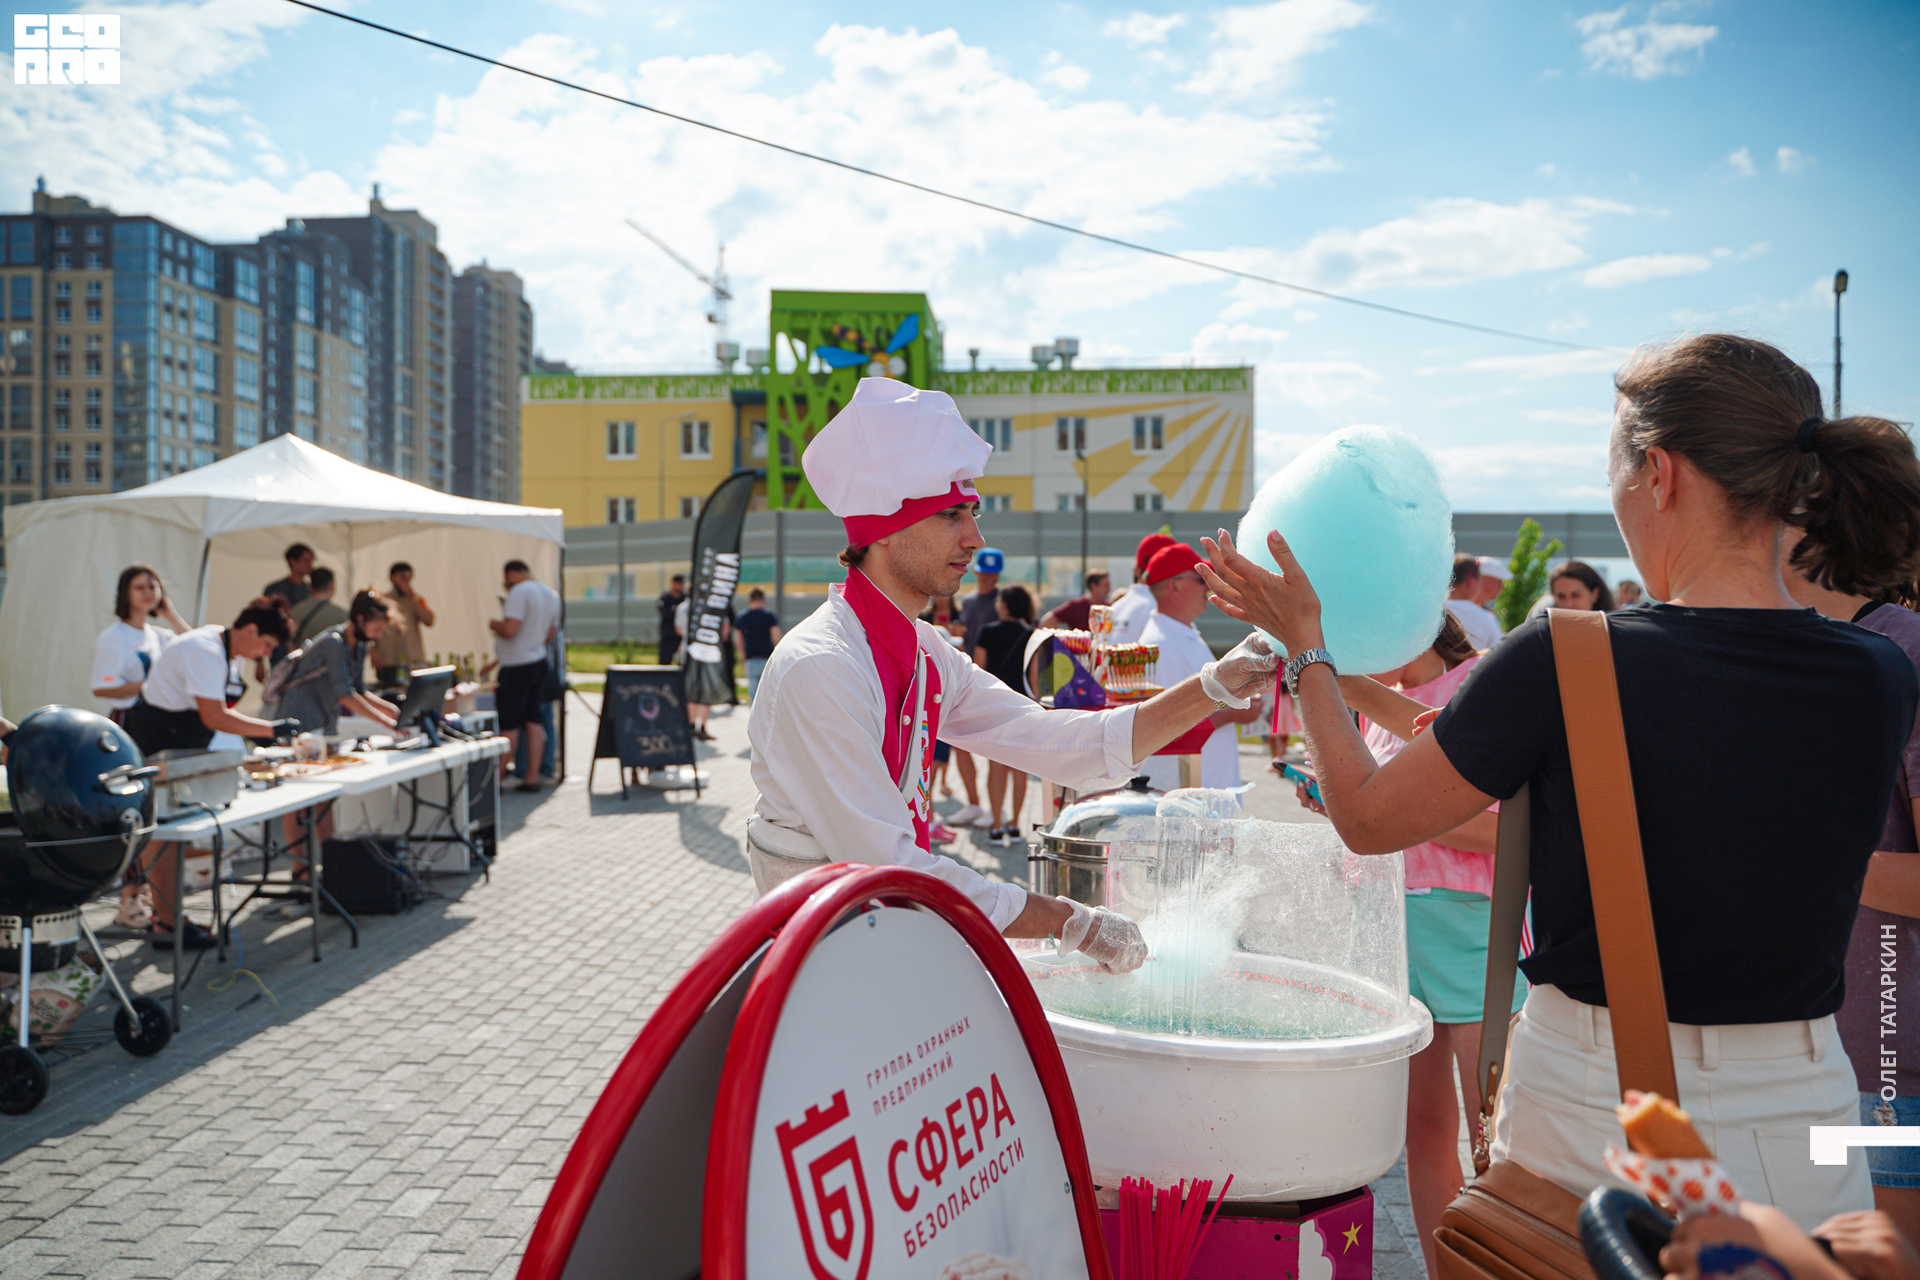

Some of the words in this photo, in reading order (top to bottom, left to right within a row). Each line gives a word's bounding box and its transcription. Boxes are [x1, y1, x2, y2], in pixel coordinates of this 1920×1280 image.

[706, 552, 740, 610] ВИНА
[866, 1051, 913, 1089] ГРУППА
[917, 1016, 970, 1059] ОХРАННЫХ
[873, 1051, 953, 1116] ПРЕДПРИЯТИЙ
[888, 1072, 1016, 1212] СФЕРА
[903, 1136, 1025, 1258] БЕЗОПАСНОСТИ
